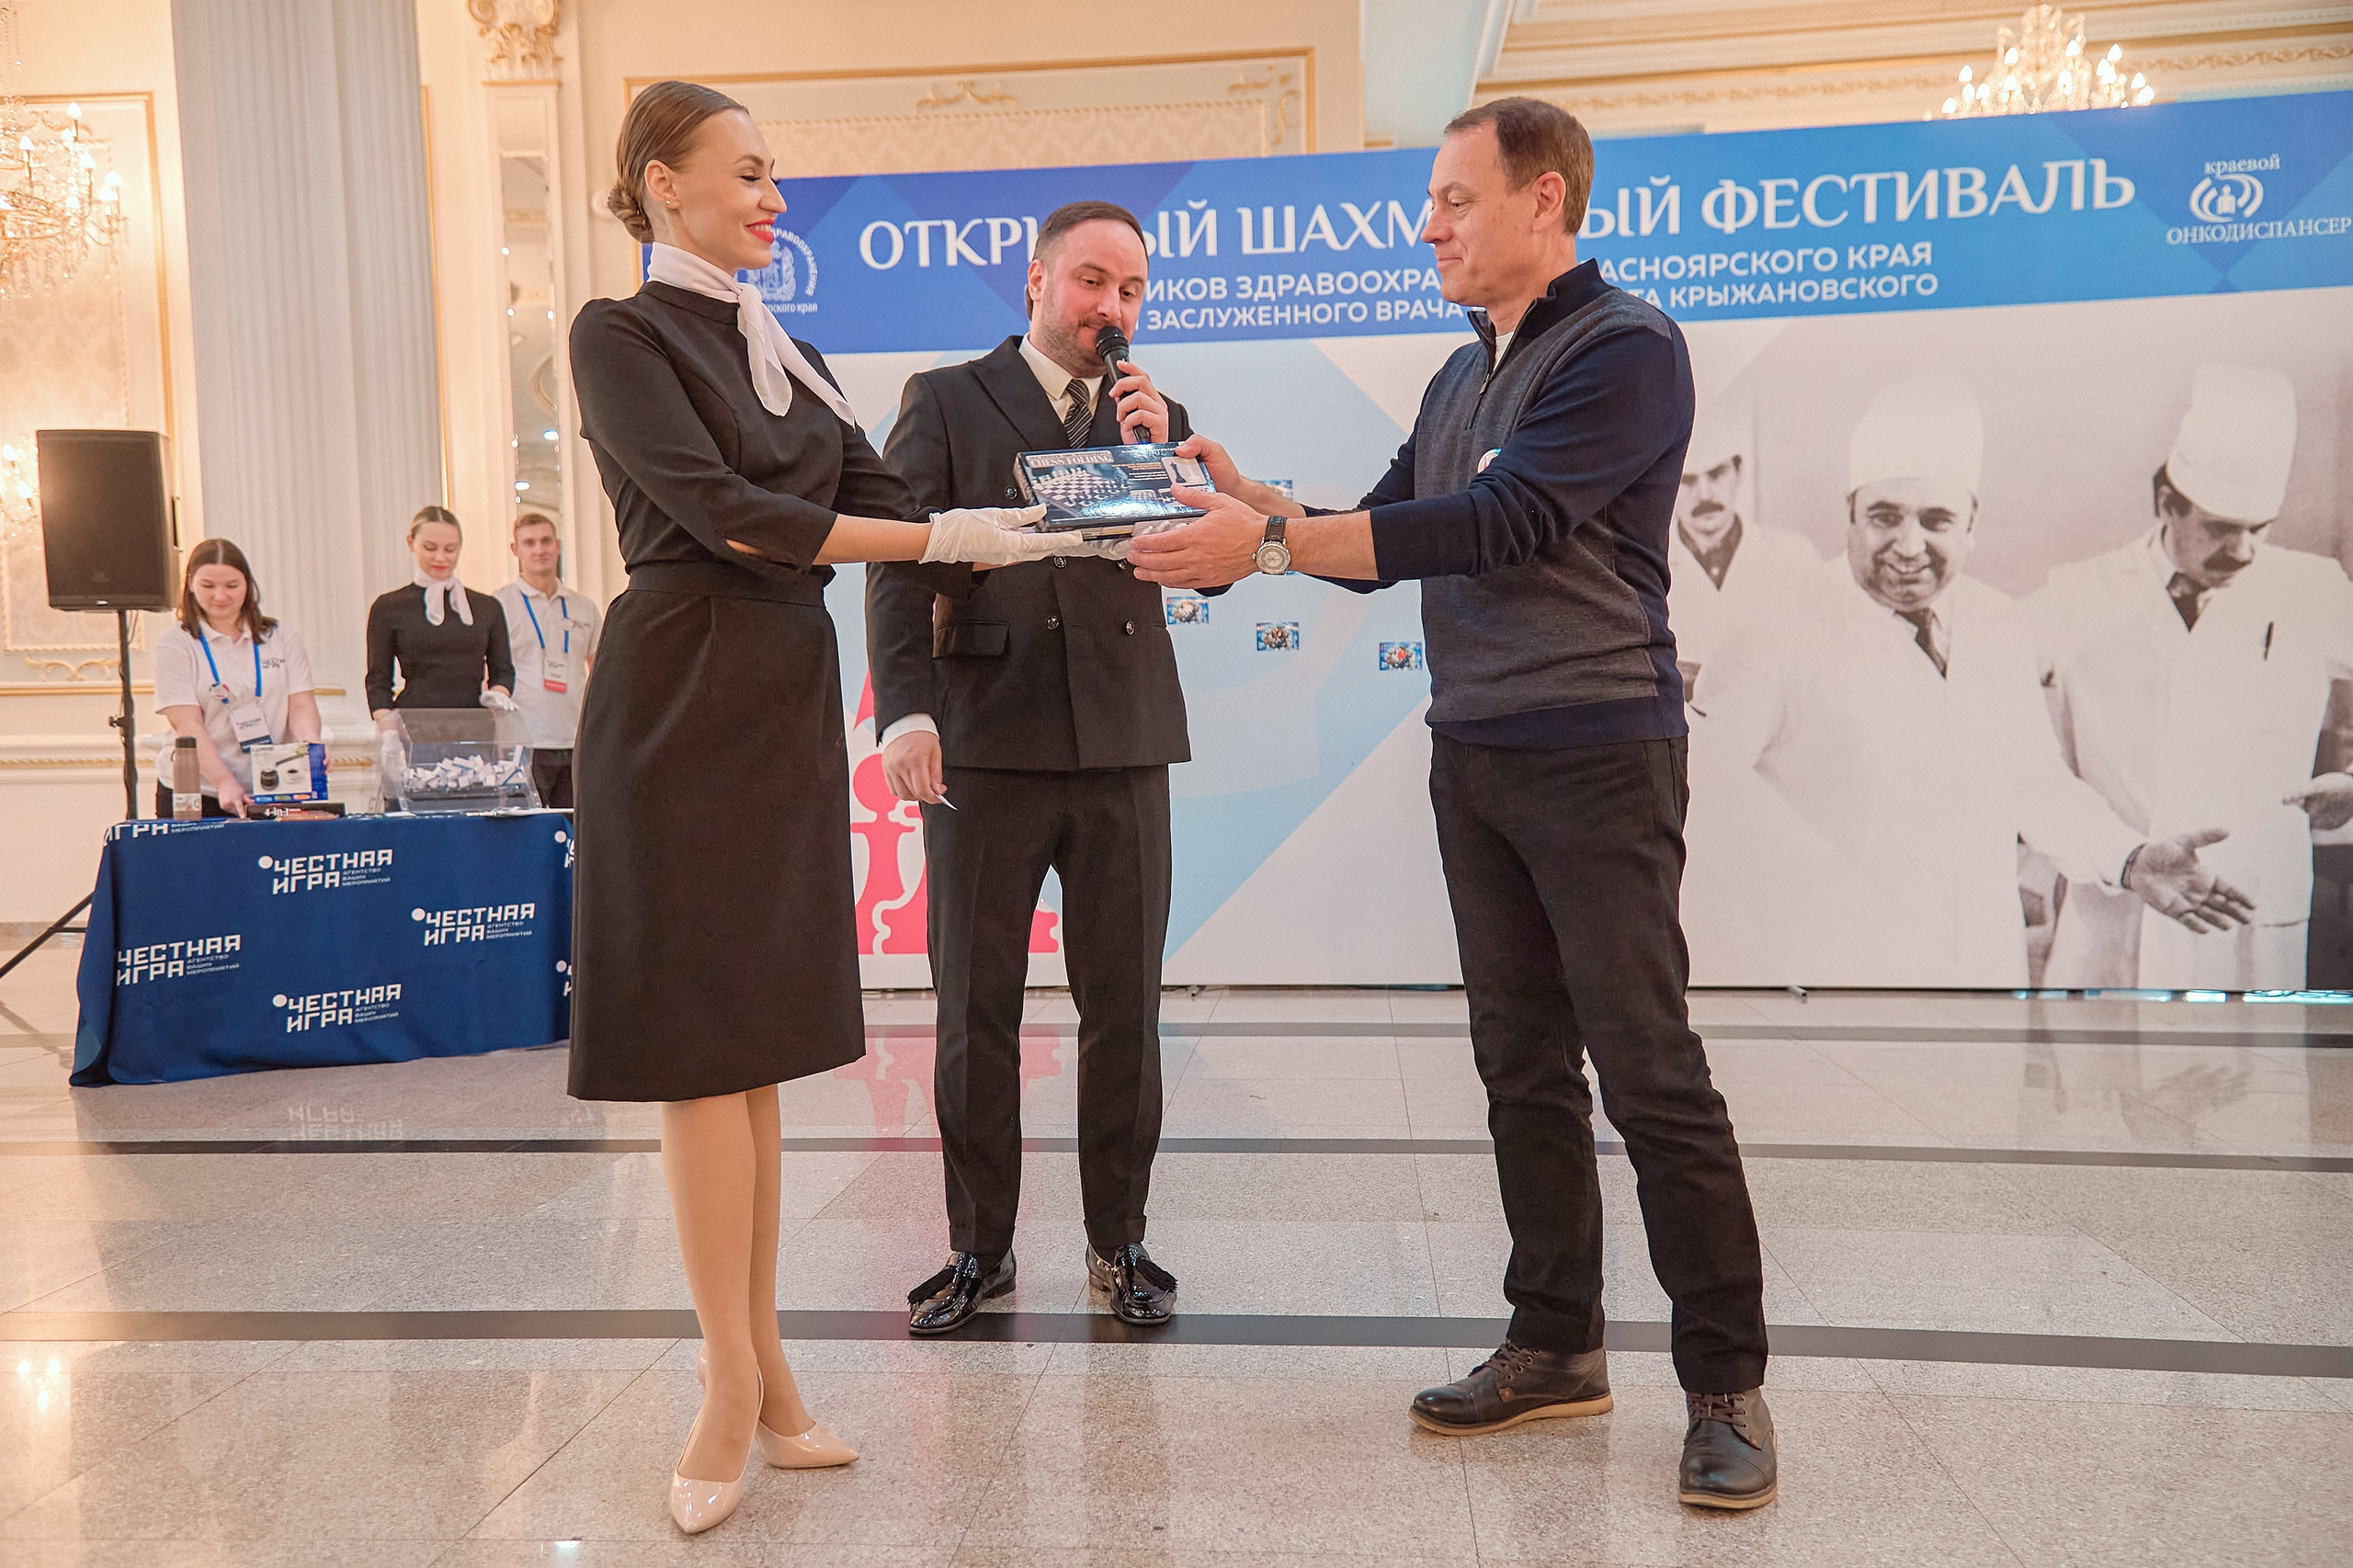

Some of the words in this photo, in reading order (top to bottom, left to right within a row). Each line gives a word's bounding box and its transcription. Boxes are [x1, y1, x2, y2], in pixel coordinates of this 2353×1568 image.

[2204, 153, 2281, 179] краевой
[859, 199, 1218, 270] ОТКРЫЙ
[1701, 158, 2136, 235] ФЕСТИВАЛЬ
[2166, 217, 2352, 244] ОНКОДИСПАНСЕР
[1579, 245, 1838, 282] АСНОЯРСКОГО
[1847, 241, 1932, 270] КРАЯ
[1147, 301, 1369, 330] ЗАСЛУЖЕННОГО
[1376, 299, 1464, 322] ВРАЧА
[1670, 273, 1938, 309] КРЫЖАНОВСКОГО
[274, 848, 392, 876] ЧЕСТНАЯ
[273, 871, 340, 895] ИГРА
[426, 903, 535, 928] ЧЕСТНАЯ
[424, 924, 484, 947] ИГРА
[118, 934, 241, 966] ЧЕСТНАЯ
[117, 960, 185, 986] ИГРА
[288, 983, 402, 1014] ЧЕСТНАЯ
[286, 1007, 353, 1033] ИГРА
